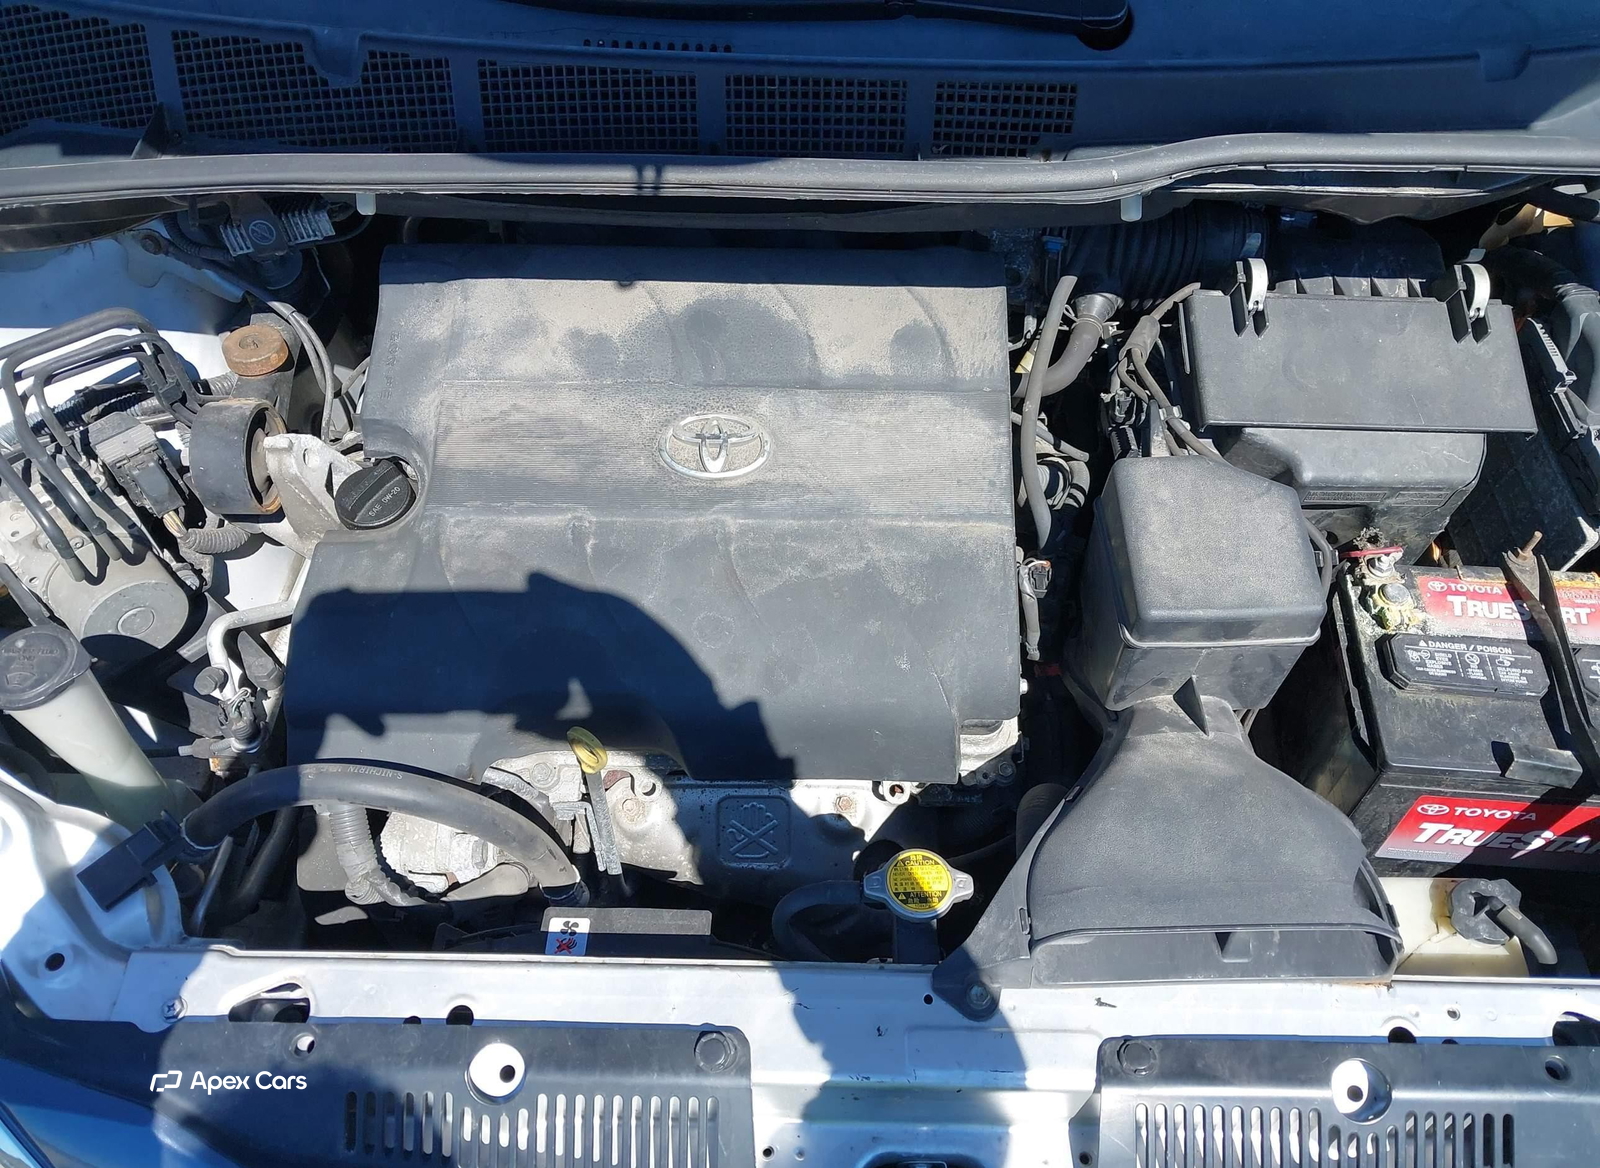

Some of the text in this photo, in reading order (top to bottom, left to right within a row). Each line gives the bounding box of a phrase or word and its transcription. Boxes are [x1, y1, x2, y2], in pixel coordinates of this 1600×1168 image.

[368, 501, 382, 517] SAE
[381, 486, 401, 504] 0W-20
[1448, 583, 1503, 595] TOYOTA
[1446, 595, 1592, 625] TRUESRT
[1428, 641, 1468, 651] DANGER
[1476, 645, 1513, 655] POISON
[348, 765, 403, 780] S-NICHIRIN
[1454, 806, 1537, 821] TOYOTA
[909, 890, 942, 898] ATTENTION
